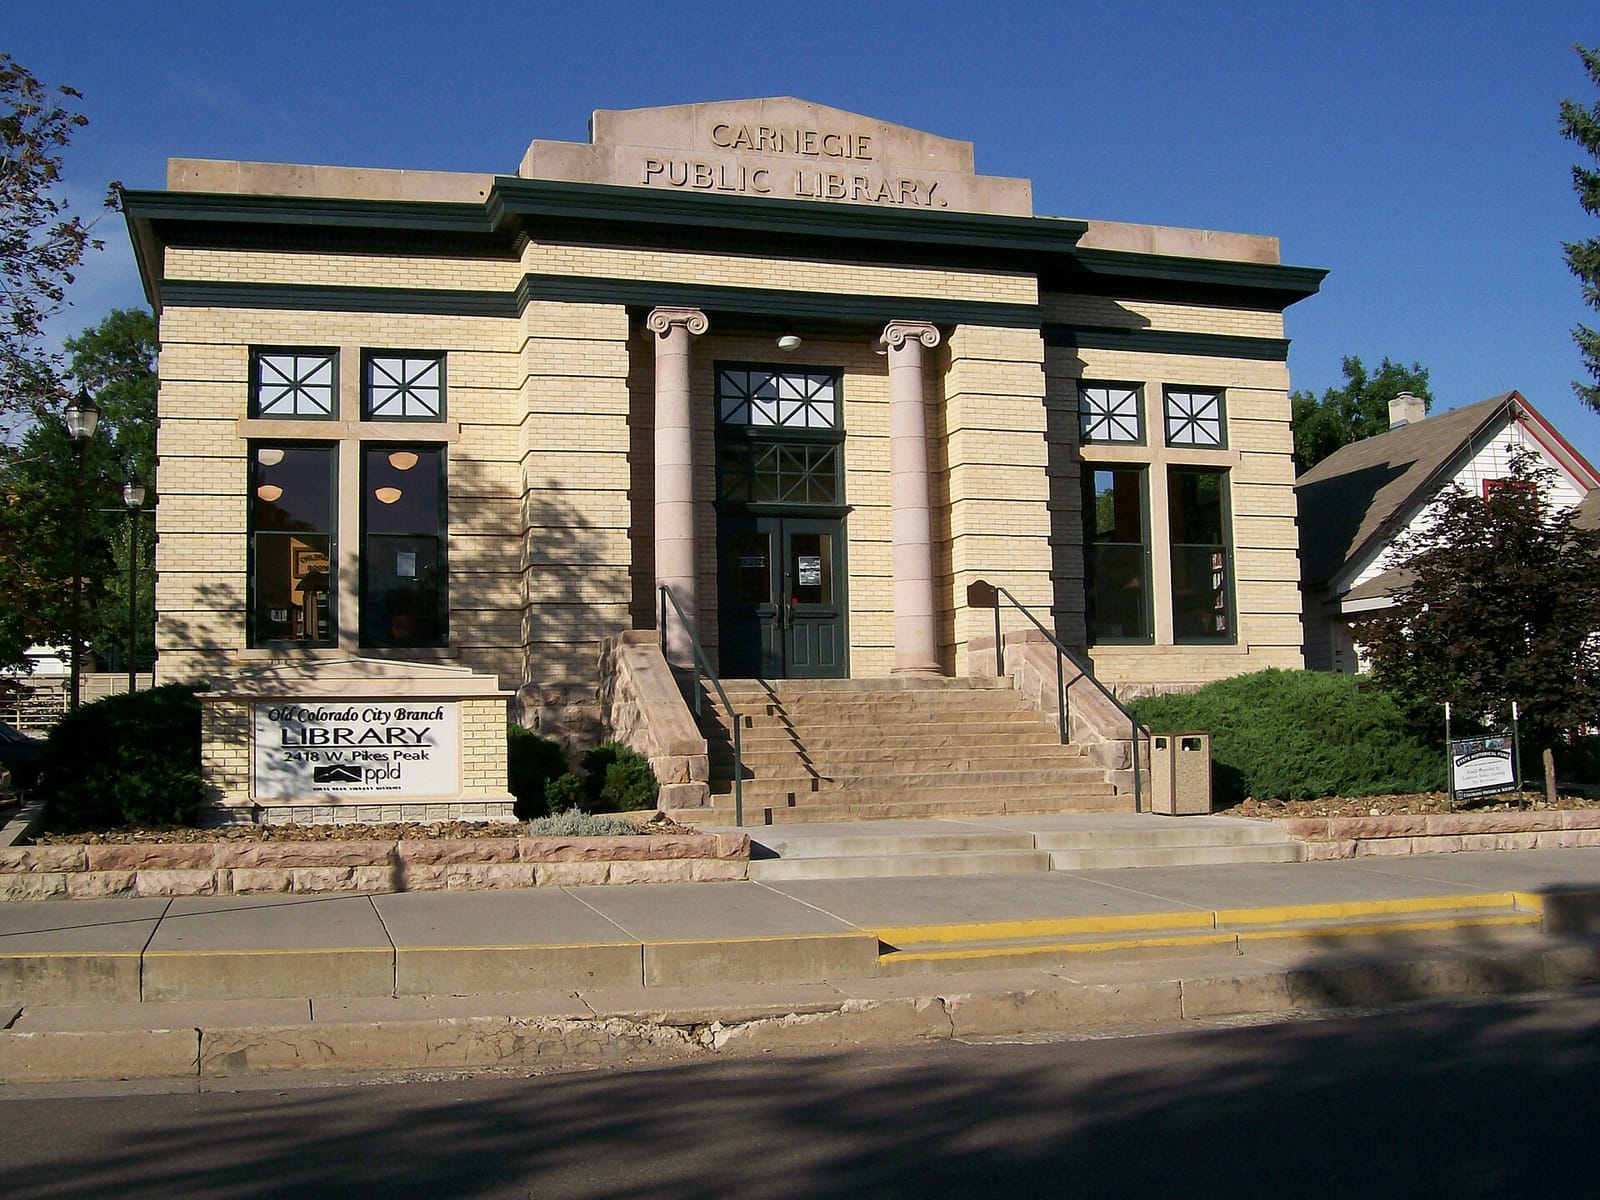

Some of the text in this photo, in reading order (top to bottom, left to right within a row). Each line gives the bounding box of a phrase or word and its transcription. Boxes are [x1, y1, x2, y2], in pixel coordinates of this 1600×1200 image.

[710, 123, 873, 160] CARNEGIE
[641, 158, 771, 193] PUBLIC
[268, 705, 444, 725] Old Colorado City Branch
[281, 727, 431, 745] LIBRARY
[283, 750, 429, 762] 2418 W. Pikes Peak
[365, 762, 400, 784] ppld
